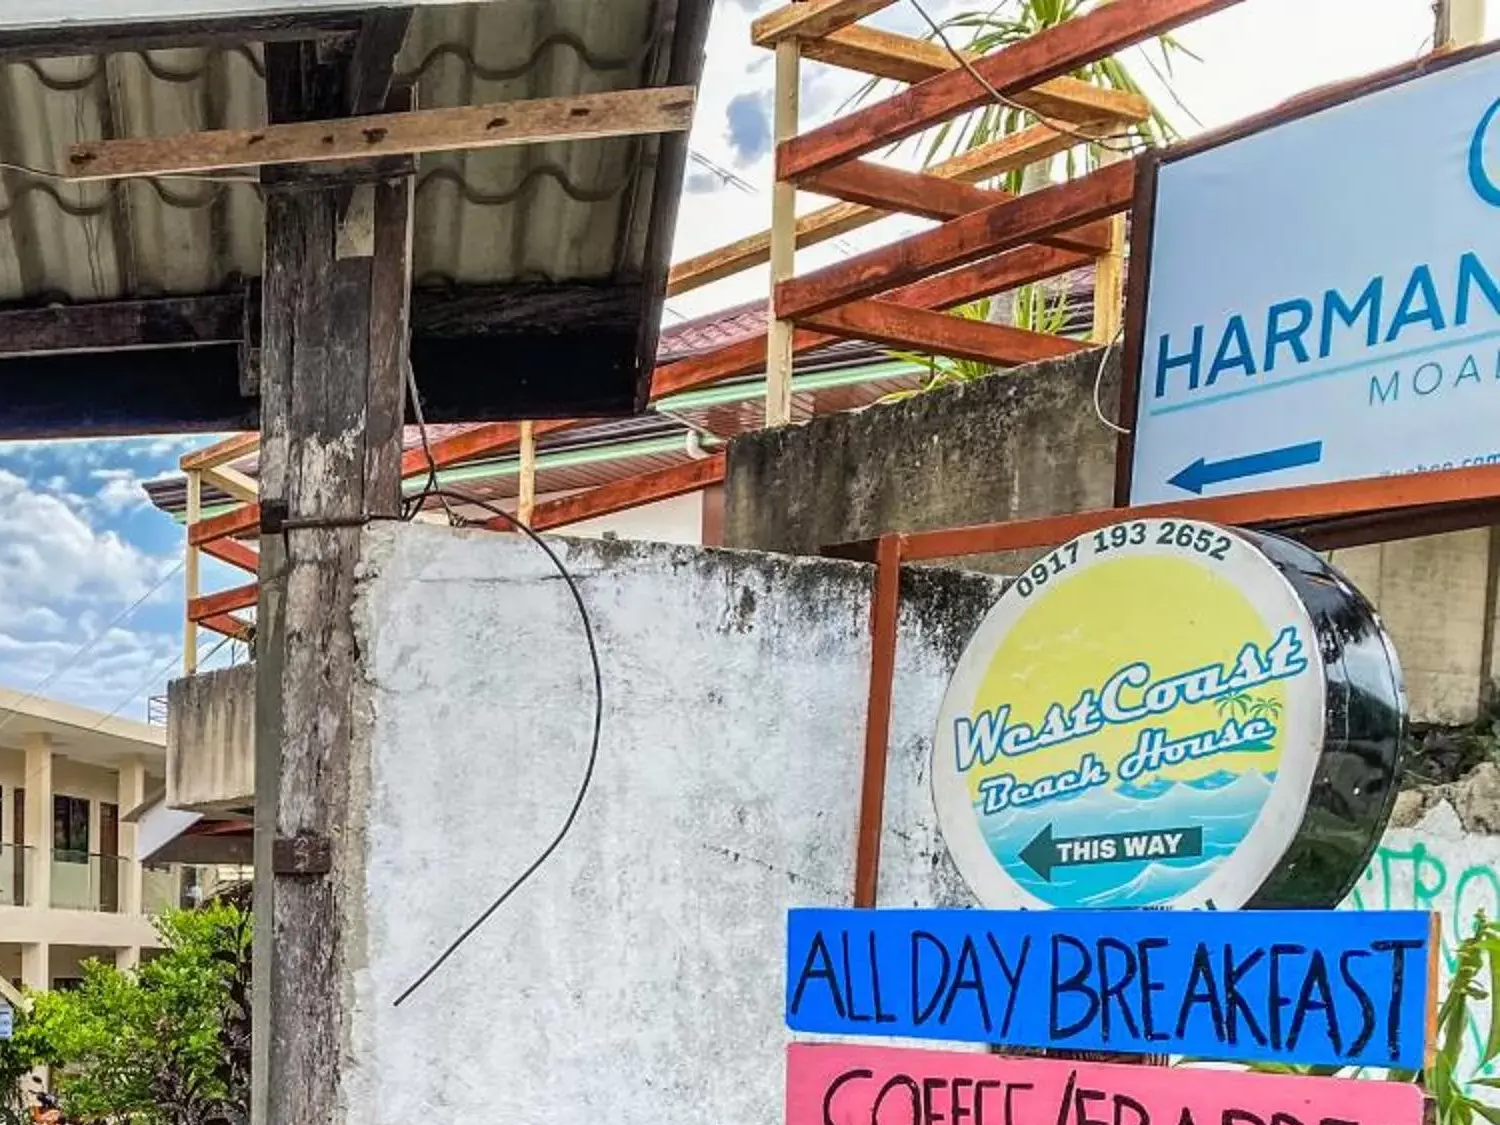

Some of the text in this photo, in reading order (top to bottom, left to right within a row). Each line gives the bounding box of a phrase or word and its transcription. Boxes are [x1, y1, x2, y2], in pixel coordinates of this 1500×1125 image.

[1154, 251, 1500, 398] HARMAN
[1016, 521, 1232, 597] 0917 193 2652
[979, 718, 1277, 815] Beach House
[1057, 833, 1184, 862] THIS WAY
[791, 931, 1426, 1062] ALL DAY BREAKFAST
